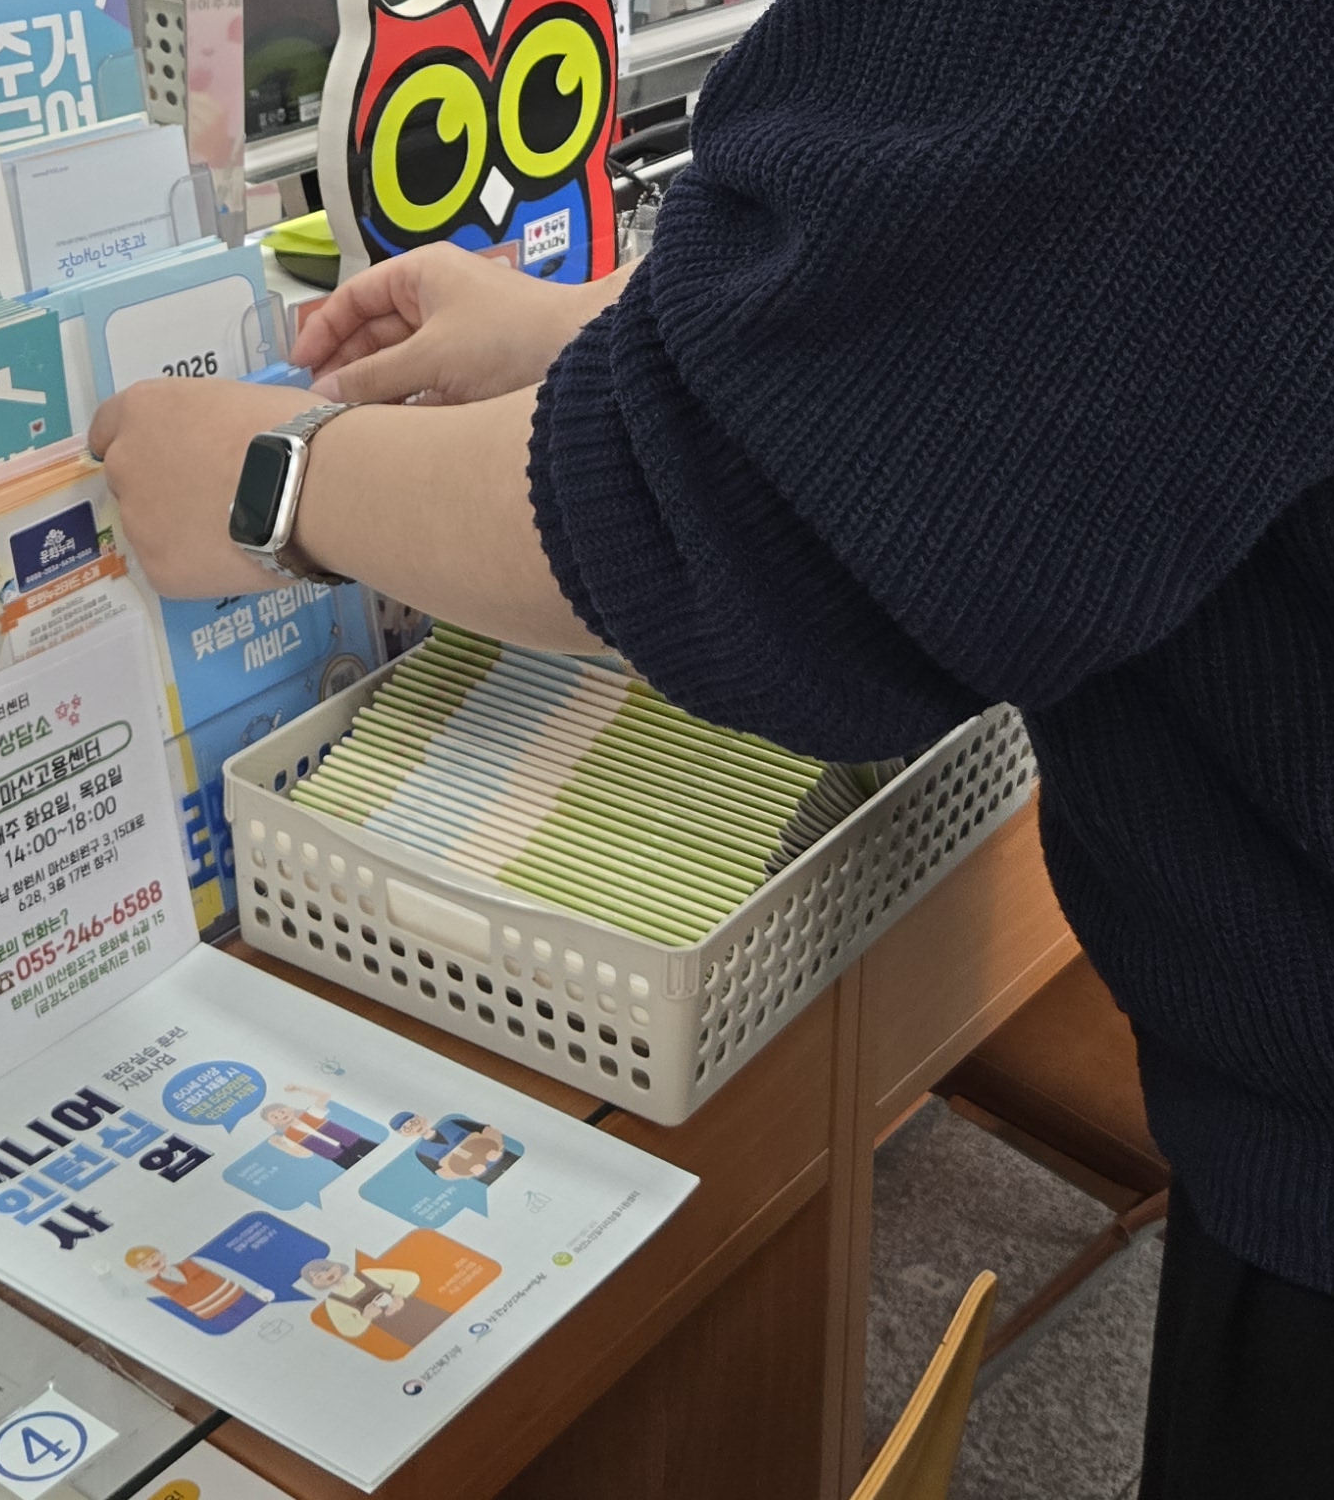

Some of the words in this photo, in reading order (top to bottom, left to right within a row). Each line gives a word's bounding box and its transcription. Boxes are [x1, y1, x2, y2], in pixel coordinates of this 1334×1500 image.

[191, 605, 255, 660] 맞춤형
[0, 737, 102, 806] 마산고용센터
[24, 792, 76, 833] 화요일,
[80, 765, 123, 800] 목요일
[5, 796, 117, 868] 14:00~18:00
[18, 890, 46, 913] 628,
[69, 863, 91, 885] 17번
[16, 880, 163, 981] 055-246-6588
[22, 908, 69, 946] 전화는?
[152, 911, 165, 925] 15
[102, 1046, 160, 1083] 현장실습
[119, 1053, 178, 1092] 지원사업
[195, 1065, 221, 1084] 이상
